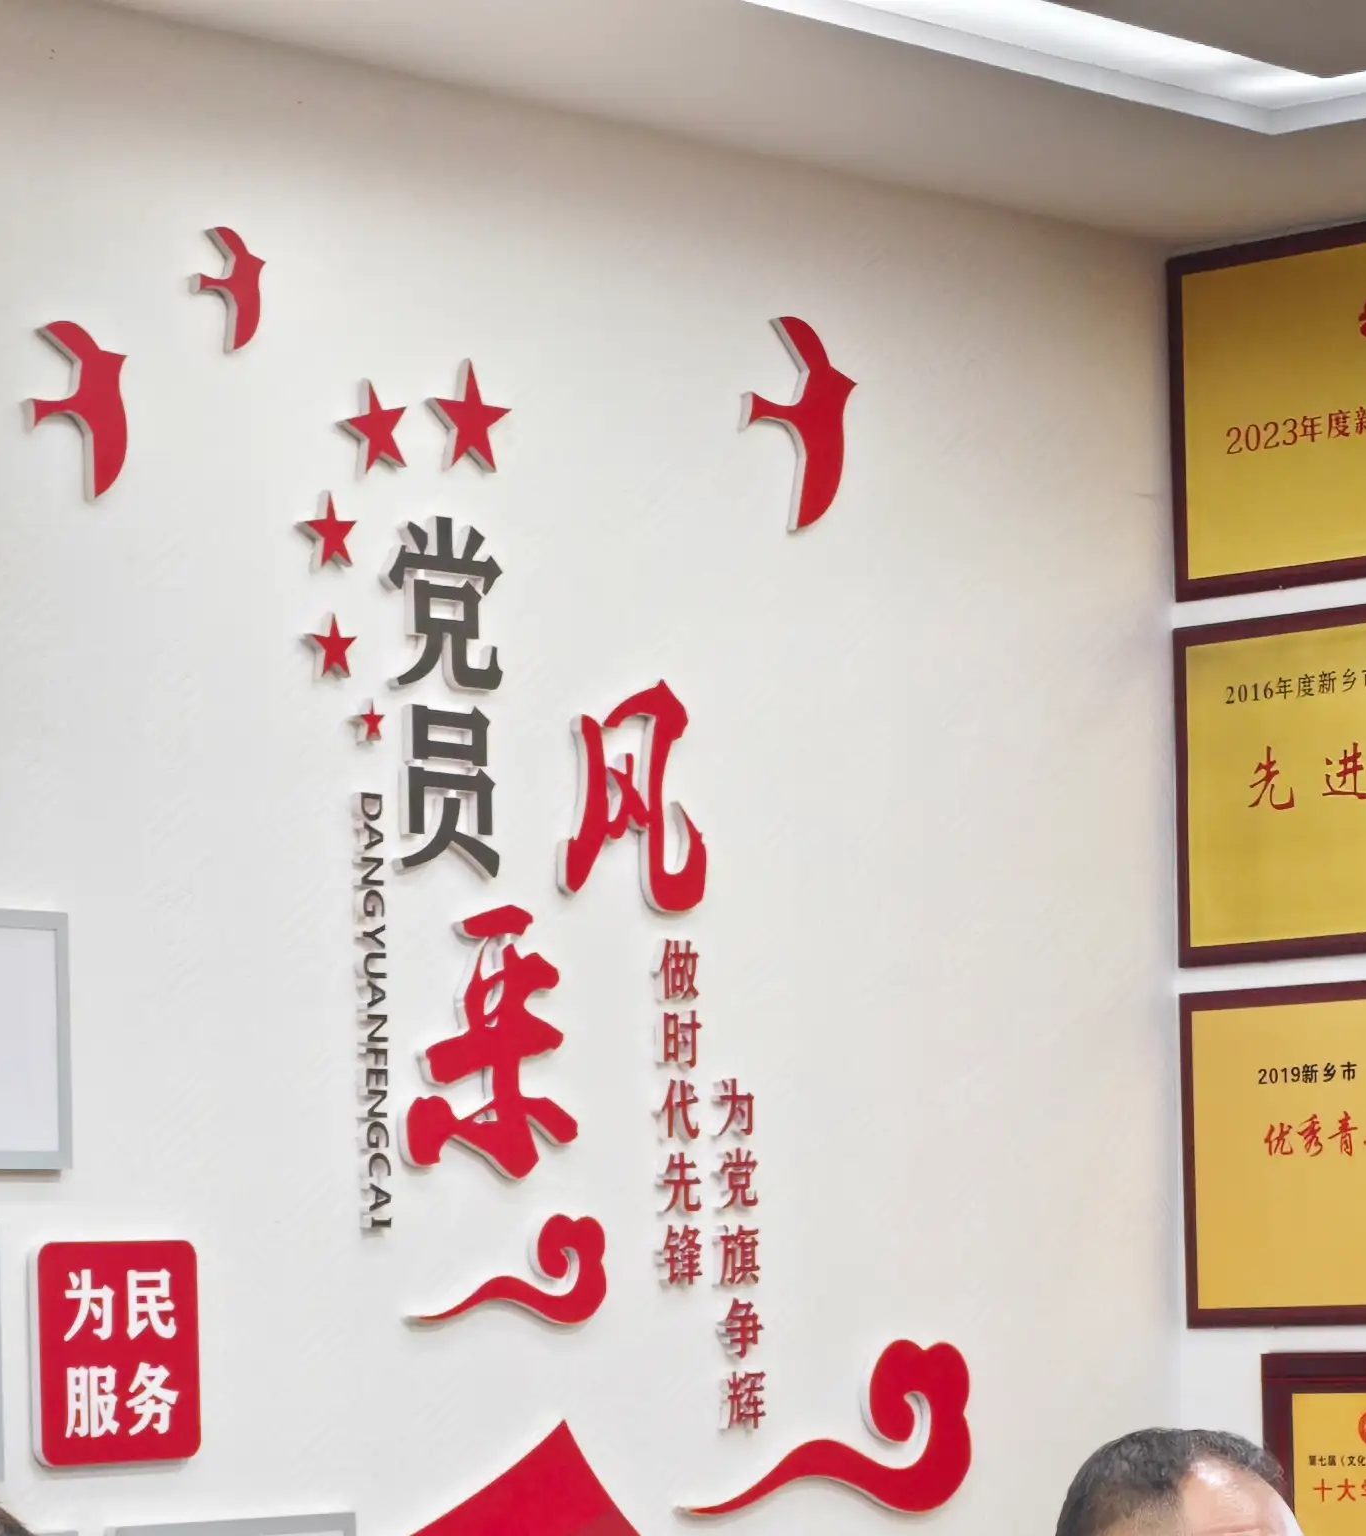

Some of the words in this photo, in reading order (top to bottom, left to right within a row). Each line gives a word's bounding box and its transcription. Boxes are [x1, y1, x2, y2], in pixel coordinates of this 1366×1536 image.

[1258, 1061, 1358, 1085] 2019新乡市
[657, 939, 703, 1288] 做时代先锋
[713, 1077, 766, 1431] 为党旗争辉
[63, 1267, 177, 1341] 为民
[65, 1361, 180, 1438] 服务
